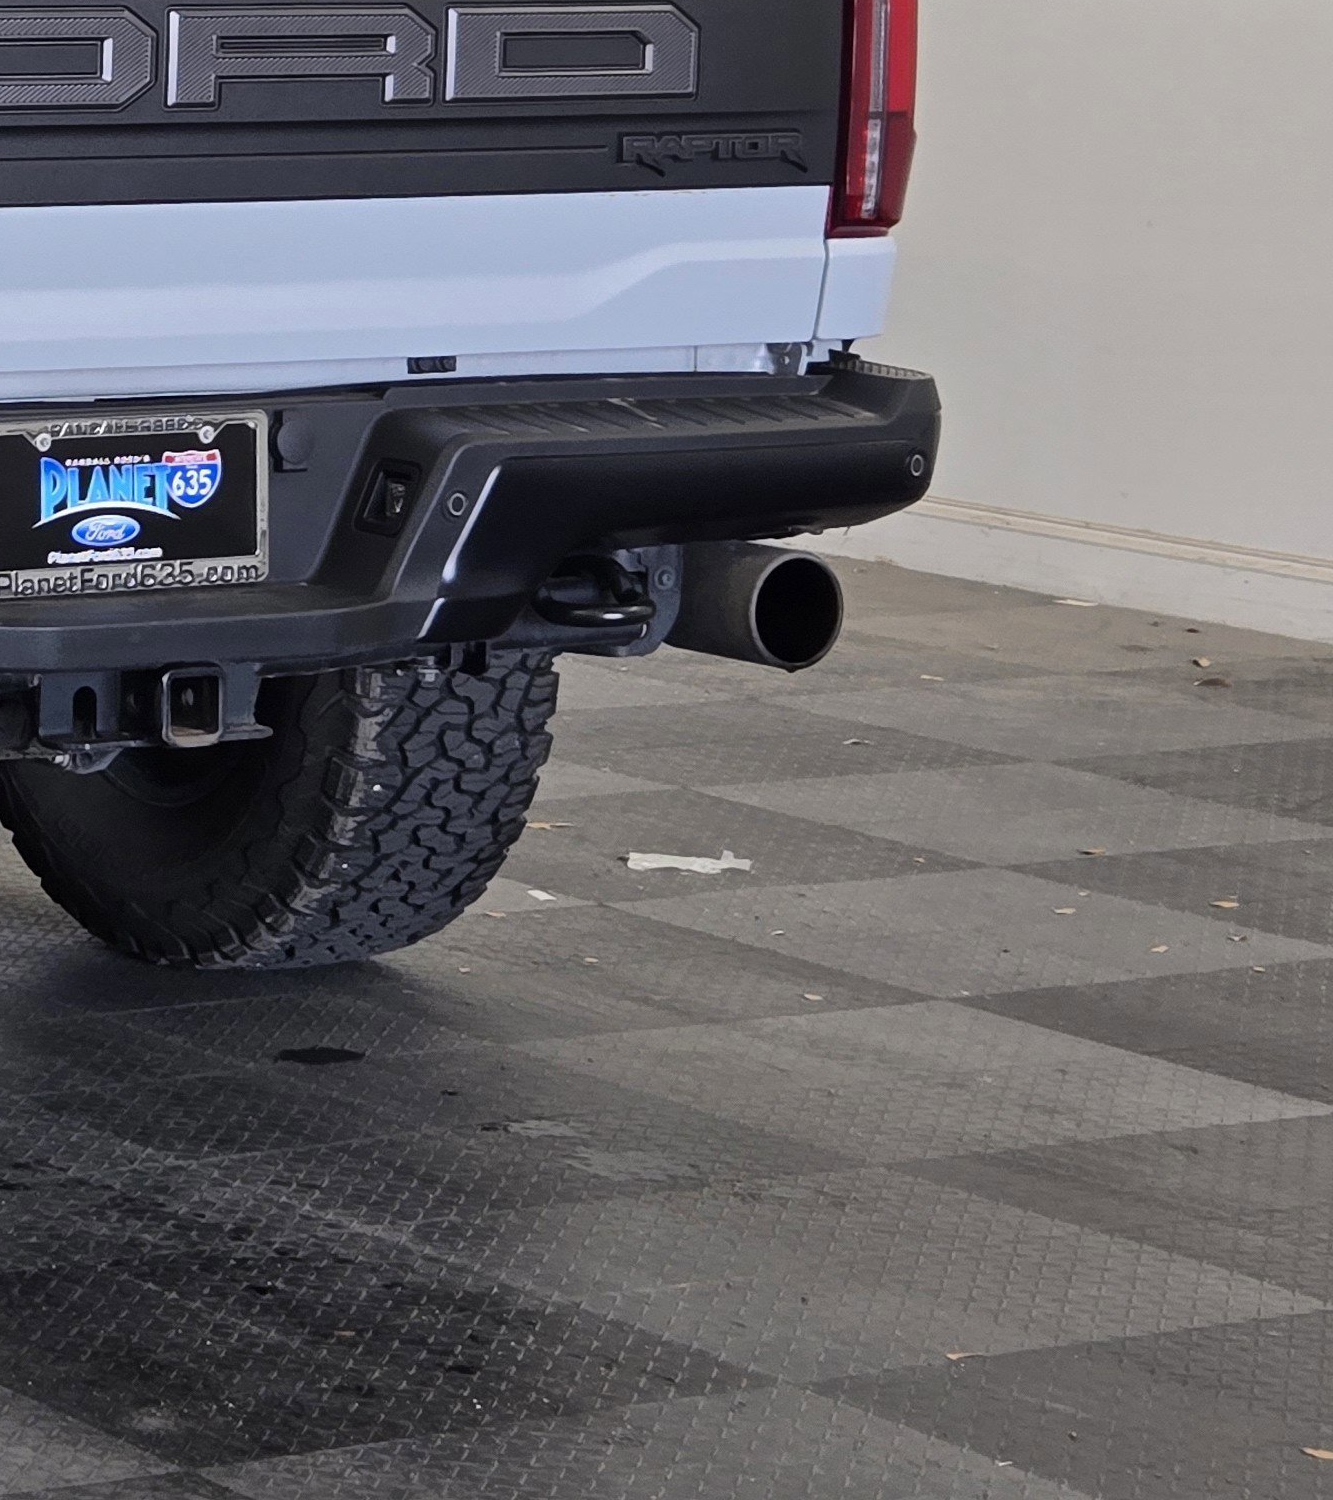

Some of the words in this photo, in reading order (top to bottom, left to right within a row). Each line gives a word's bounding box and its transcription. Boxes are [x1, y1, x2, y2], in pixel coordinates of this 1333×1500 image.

[617, 129, 809, 176] RAPTOR
[40, 457, 171, 522] PLANET
[171, 468, 212, 496] 635
[85, 519, 127, 541] Ford
